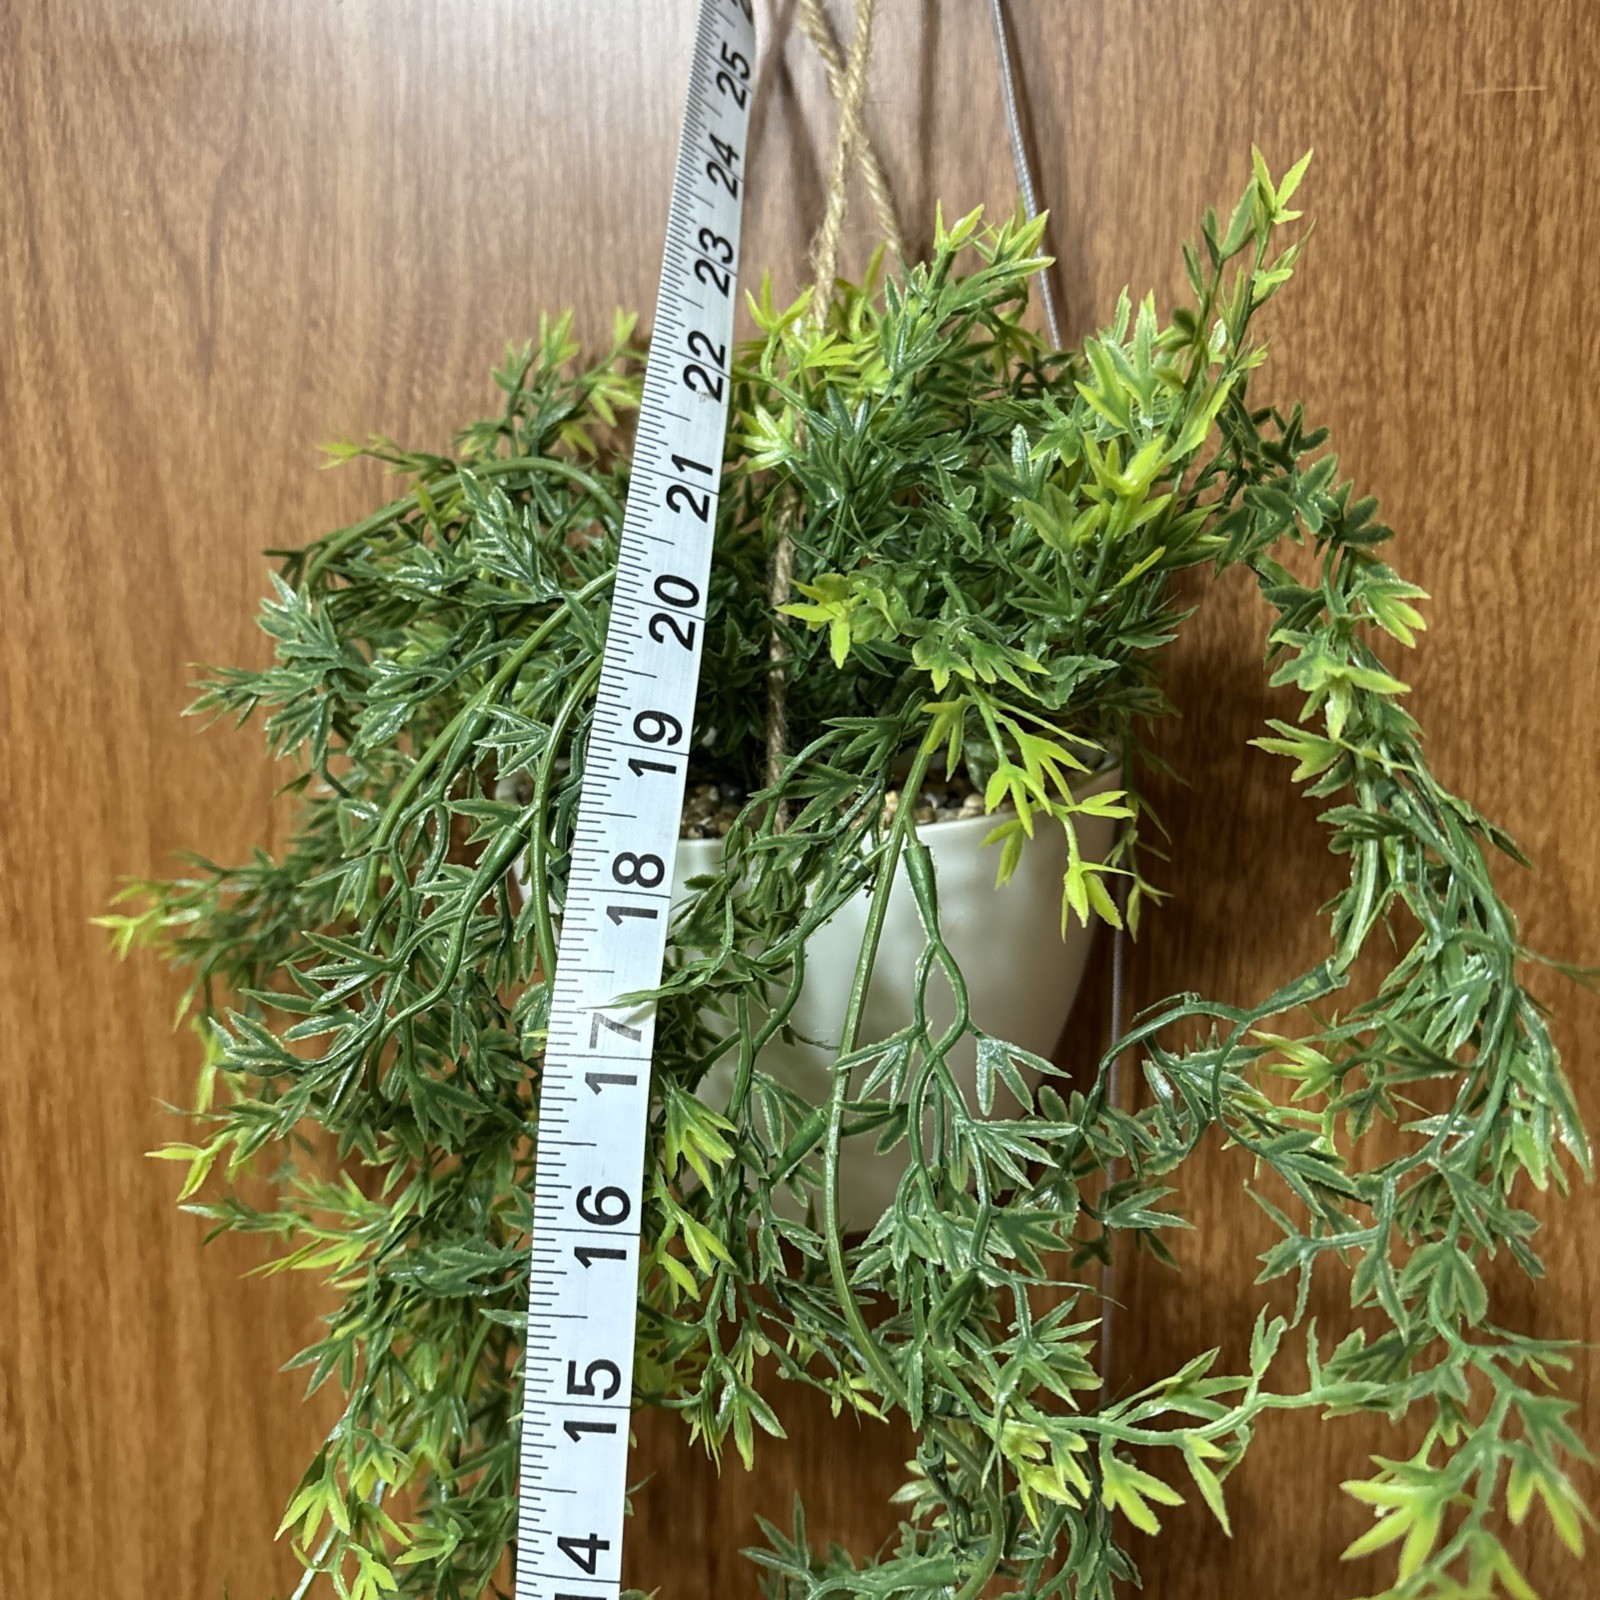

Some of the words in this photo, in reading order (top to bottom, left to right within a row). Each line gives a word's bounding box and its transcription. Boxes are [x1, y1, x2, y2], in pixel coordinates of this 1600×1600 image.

[716, 41, 751, 111] 25
[706, 133, 740, 200] 24
[694, 227, 734, 298] 23
[682, 330, 726, 403] 22
[666, 453, 714, 523] 21
[648, 574, 700, 652] 20
[627, 709, 683, 778] 19
[606, 851, 665, 927] 18
[584, 1011, 643, 1096] 17
[573, 1185, 631, 1270] 16
[563, 1358, 622, 1443] 15
